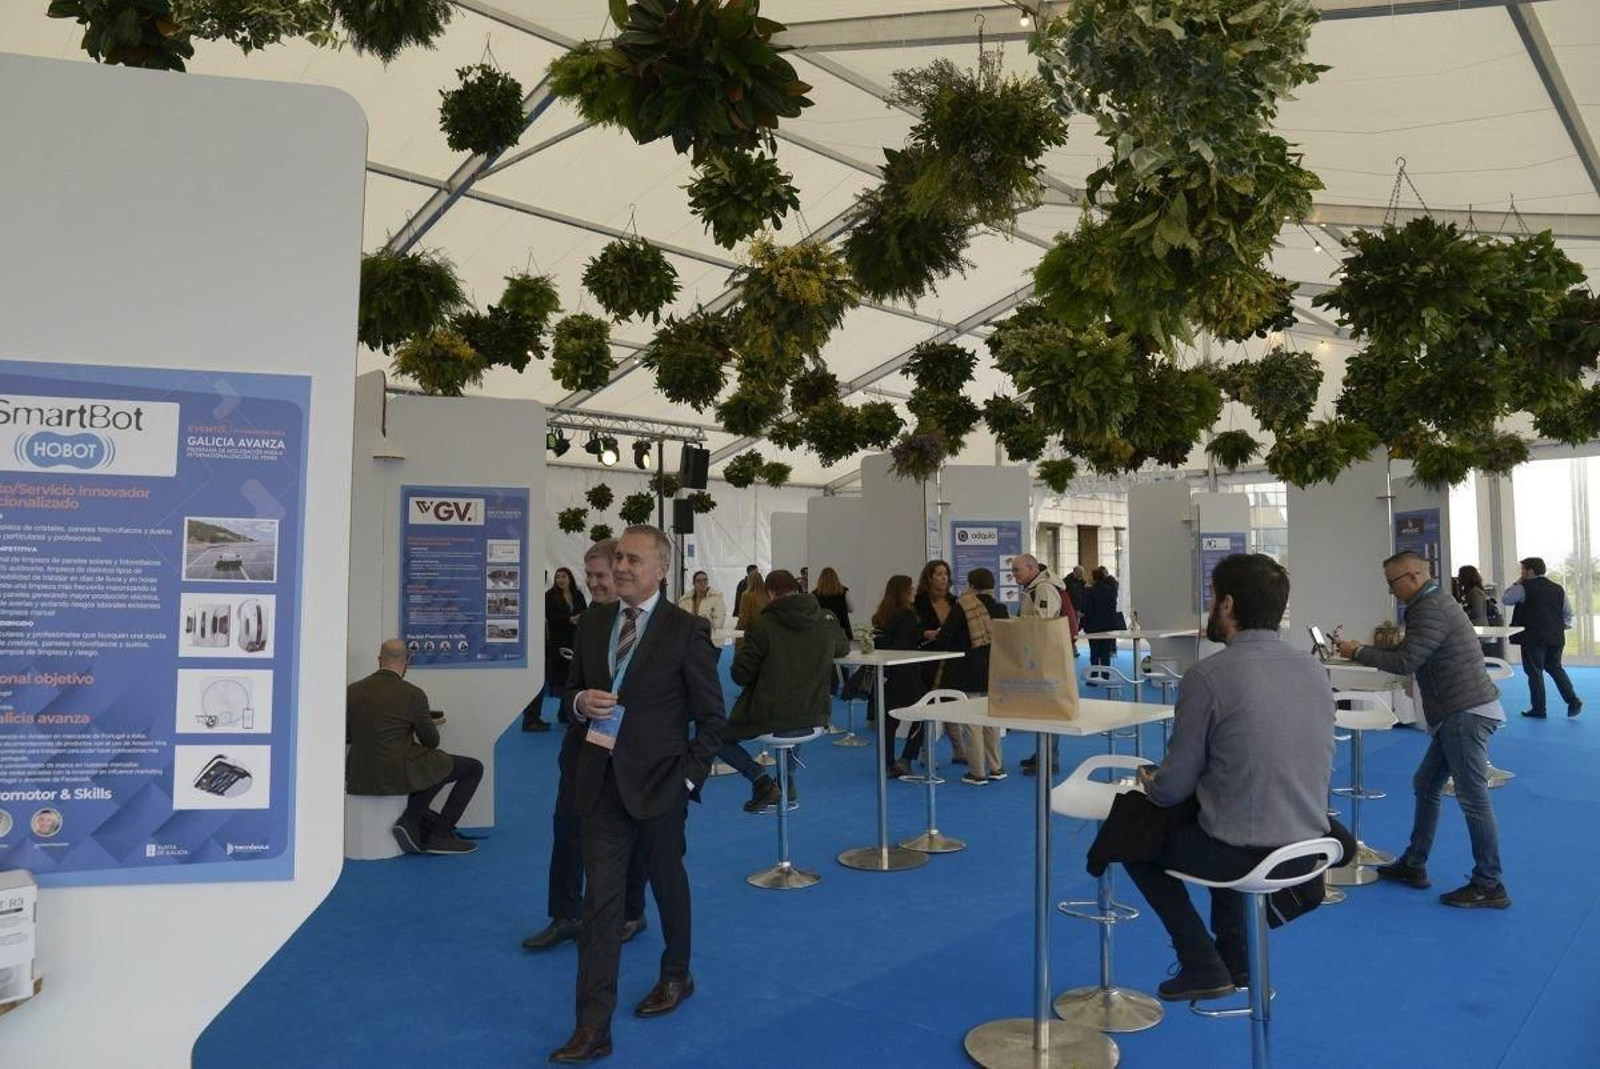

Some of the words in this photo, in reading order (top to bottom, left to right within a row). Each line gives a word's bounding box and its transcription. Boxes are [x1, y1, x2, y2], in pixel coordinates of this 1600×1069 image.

[33, 441, 97, 459] HOBOT
[187, 436, 235, 447] GALICIA
[238, 438, 286, 450] AVANZA
[79, 484, 150, 500] Innovador
[34, 672, 94, 686] objetivo
[38, 714, 91, 725] avanza
[60, 788, 71, 800] &
[74, 788, 112, 800] Skills
